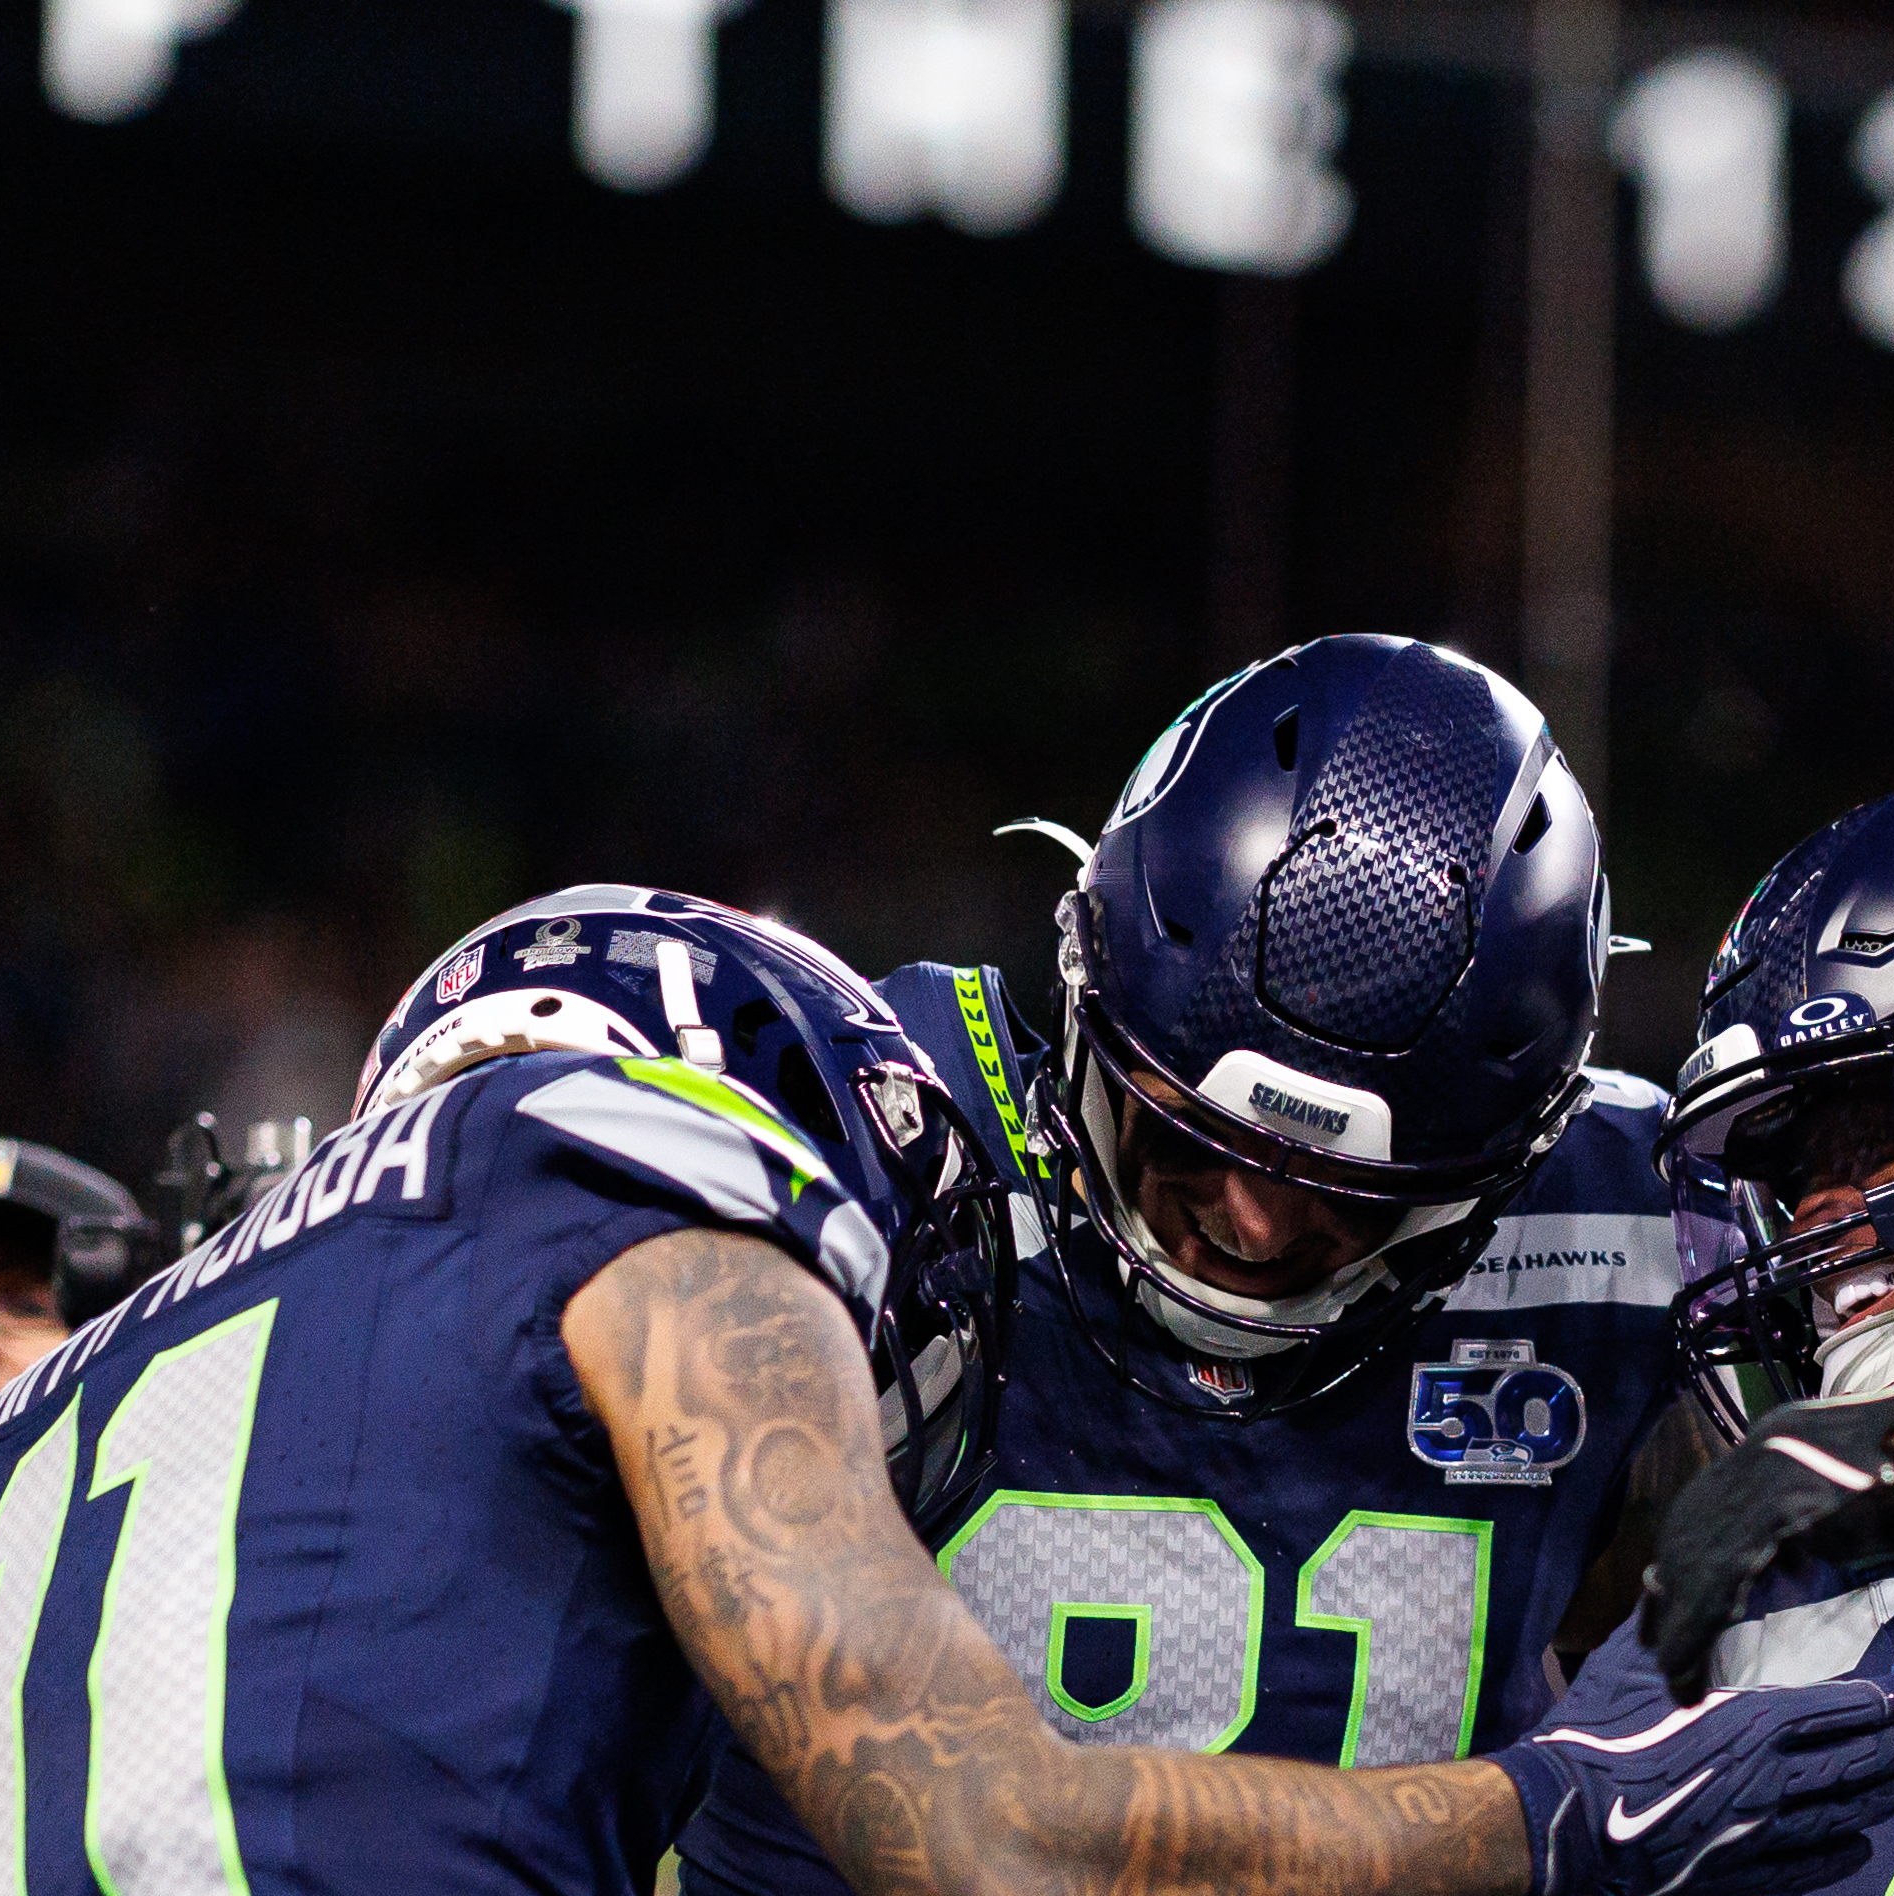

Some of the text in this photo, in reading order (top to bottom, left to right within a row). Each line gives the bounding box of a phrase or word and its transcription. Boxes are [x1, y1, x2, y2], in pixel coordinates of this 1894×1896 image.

[443, 967, 474, 995] NFL
[415, 1016, 463, 1056] LOVE
[1780, 1013, 1865, 1048] OAKLEY
[1248, 1082, 1350, 1136] SEAHAWKS
[1412, 1369, 1583, 1466] 50
